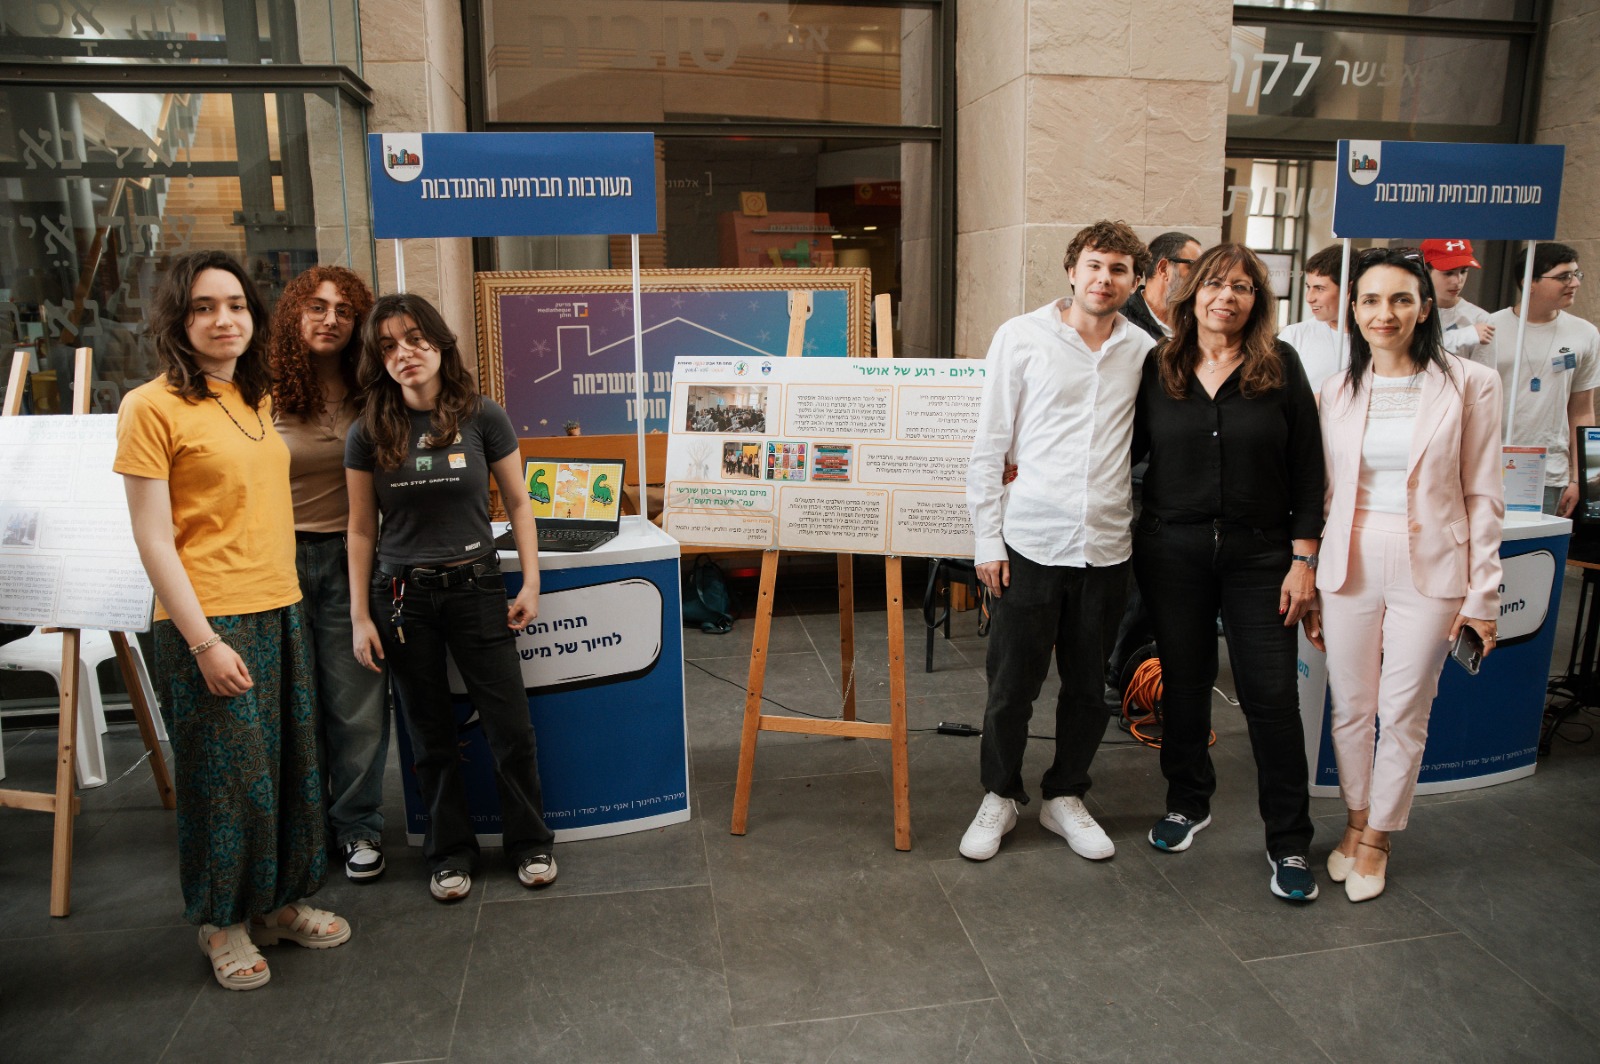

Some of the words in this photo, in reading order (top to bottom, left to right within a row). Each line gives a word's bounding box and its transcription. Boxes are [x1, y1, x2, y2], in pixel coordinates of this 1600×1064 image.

[421, 177, 496, 199] והתנדבות
[501, 177, 562, 199] חברתית
[567, 176, 632, 198] מעורבות
[1375, 182, 1434, 203] והתנדבות
[1437, 184, 1487, 204] חברתית
[1490, 184, 1542, 205] מעורבות
[852, 364, 889, 376] אושר"
[893, 365, 911, 376] של
[915, 367, 935, 377] רגע
[949, 366, 975, 377] ליום
[700, 488, 722, 496] בסימן
[724, 489, 748, 497] מצטיין
[749, 489, 767, 497] מיזם
[714, 497, 735, 505] לשנת
[553, 616, 588, 632] תהיו
[554, 641, 578, 655] של
[581, 632, 622, 652] לחיוך
[518, 646, 552, 661] מיש
[635, 796, 662, 808] החינוך
[663, 791, 686, 802] מינהל
[578, 806, 598, 816] יסודי
[599, 804, 611, 813] על
[613, 802, 629, 811] אגף
